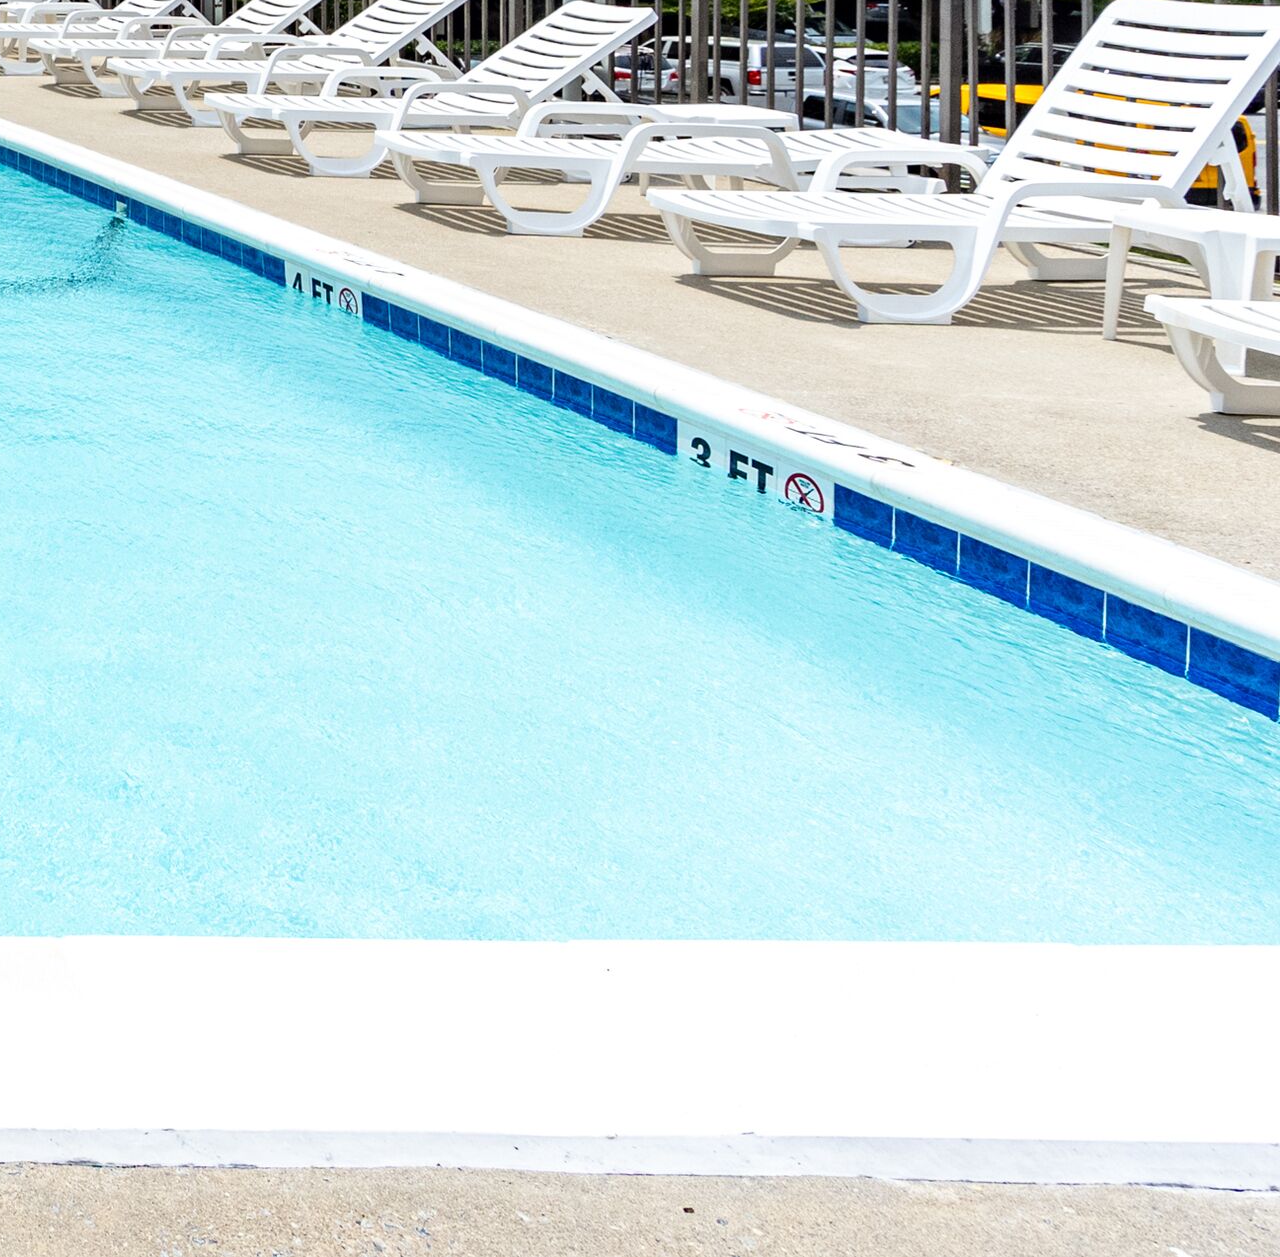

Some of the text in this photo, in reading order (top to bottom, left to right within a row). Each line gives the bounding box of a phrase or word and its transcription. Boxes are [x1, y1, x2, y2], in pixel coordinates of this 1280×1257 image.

[292, 272, 333, 304] 4 FT
[690, 437, 774, 494] 3 FT
